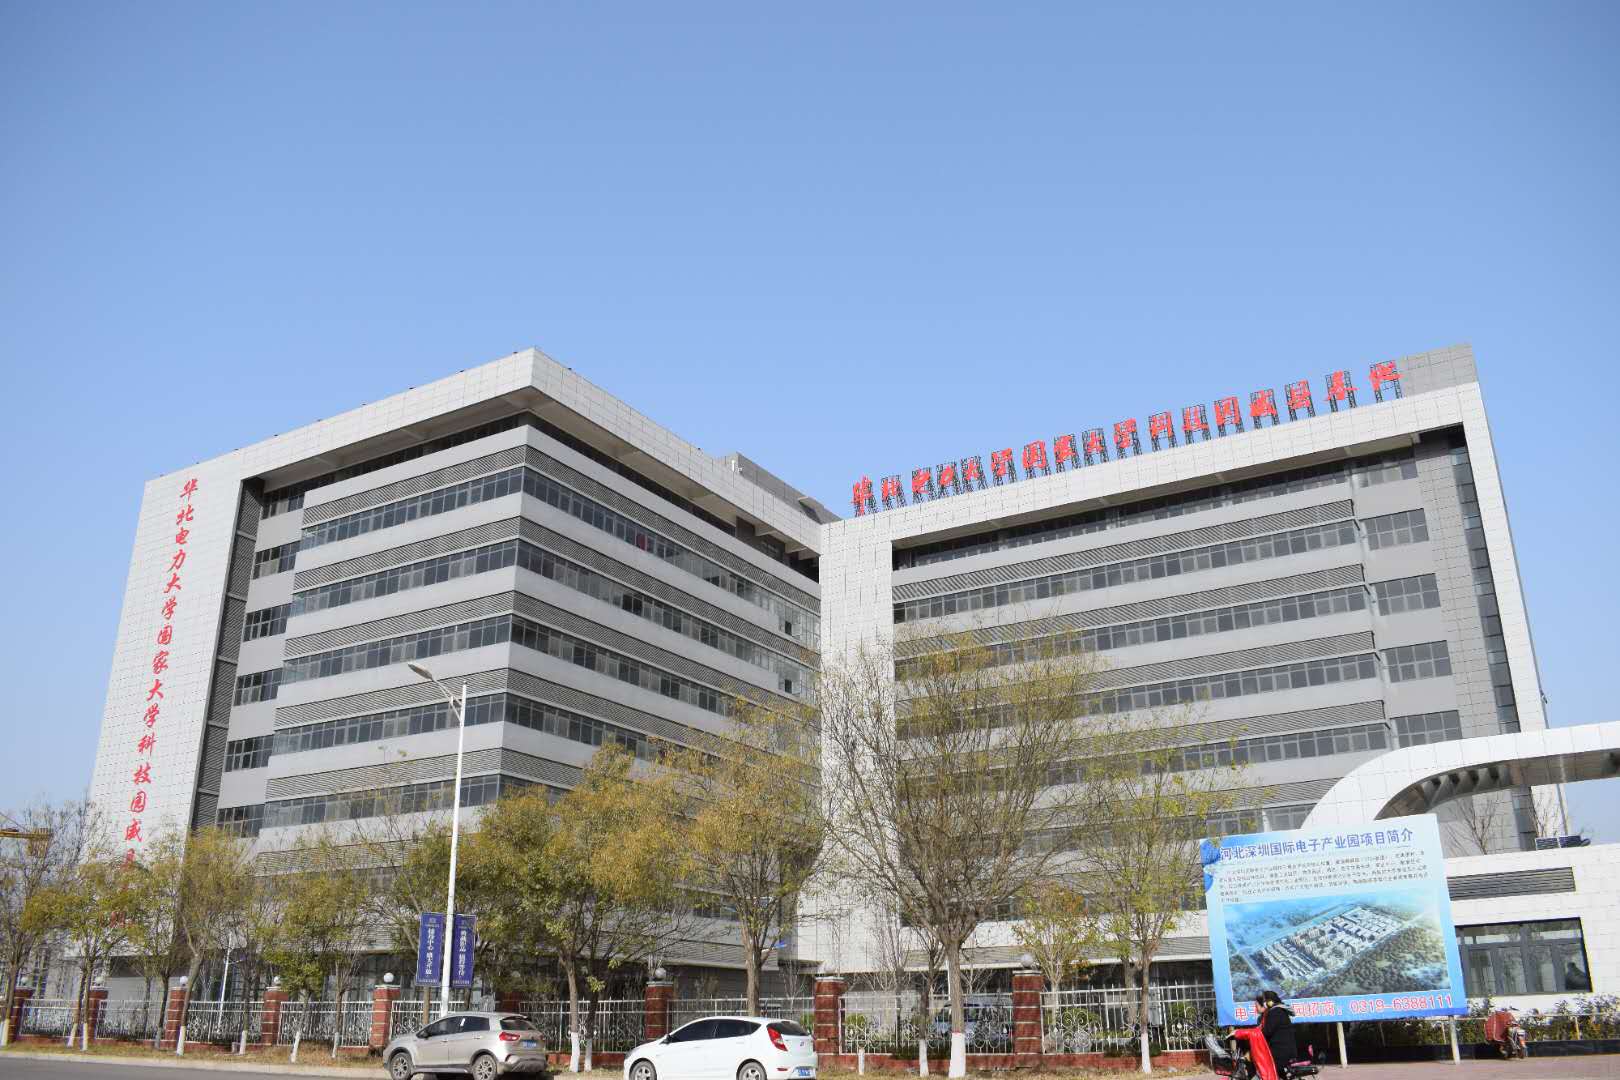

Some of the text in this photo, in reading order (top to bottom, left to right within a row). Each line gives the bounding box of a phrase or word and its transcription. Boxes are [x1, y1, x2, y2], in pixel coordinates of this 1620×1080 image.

[1220, 827, 1413, 862] 河北深圳国际电子产业园项目简介
